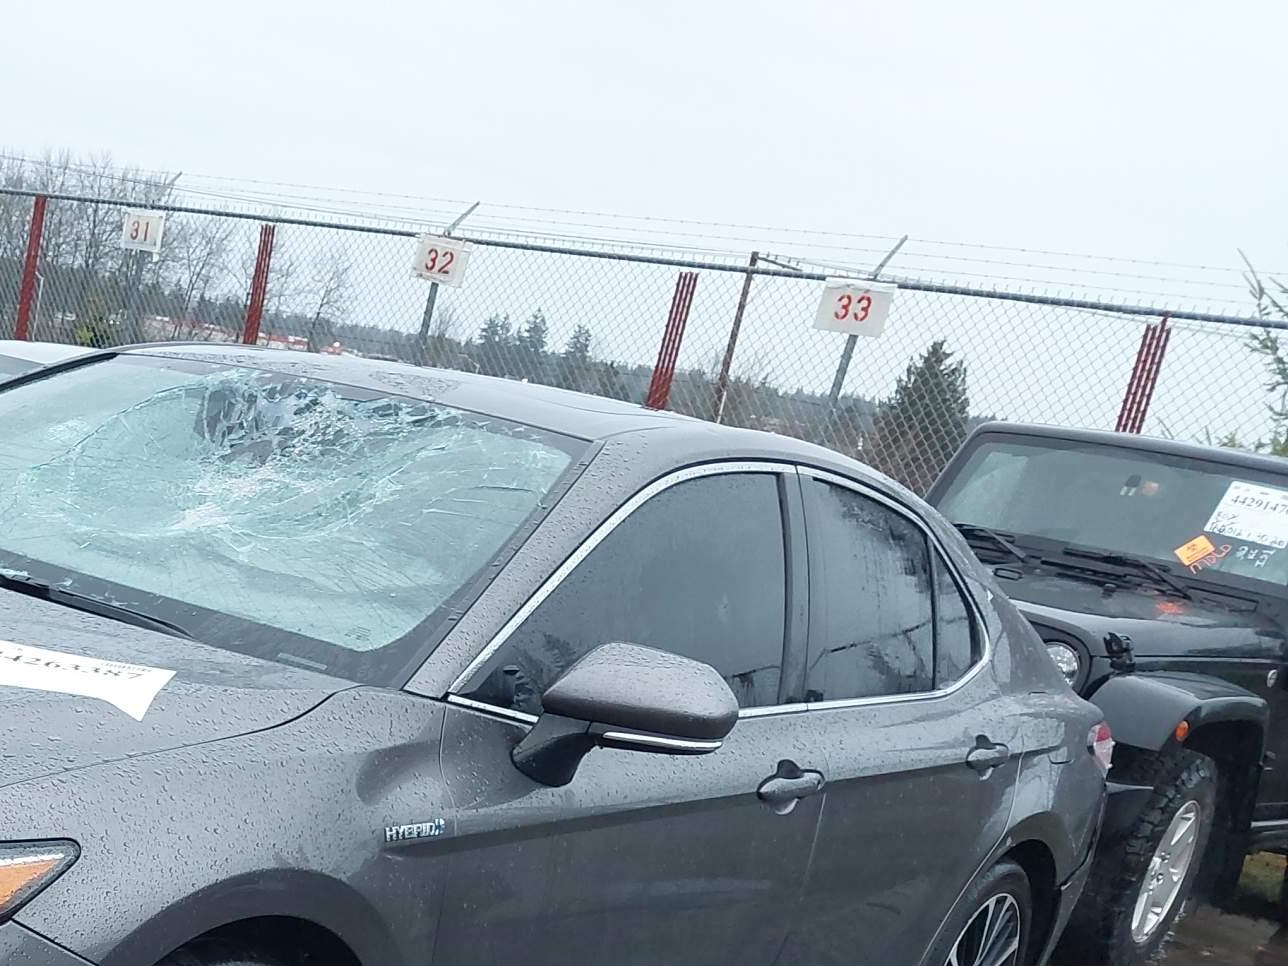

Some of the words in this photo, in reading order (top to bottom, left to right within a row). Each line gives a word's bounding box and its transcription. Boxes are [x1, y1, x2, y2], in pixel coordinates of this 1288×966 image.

[130, 220, 150, 242] 31
[425, 248, 454, 275] 32
[834, 294, 872, 322] 33
[385, 822, 436, 841] HYBRID
